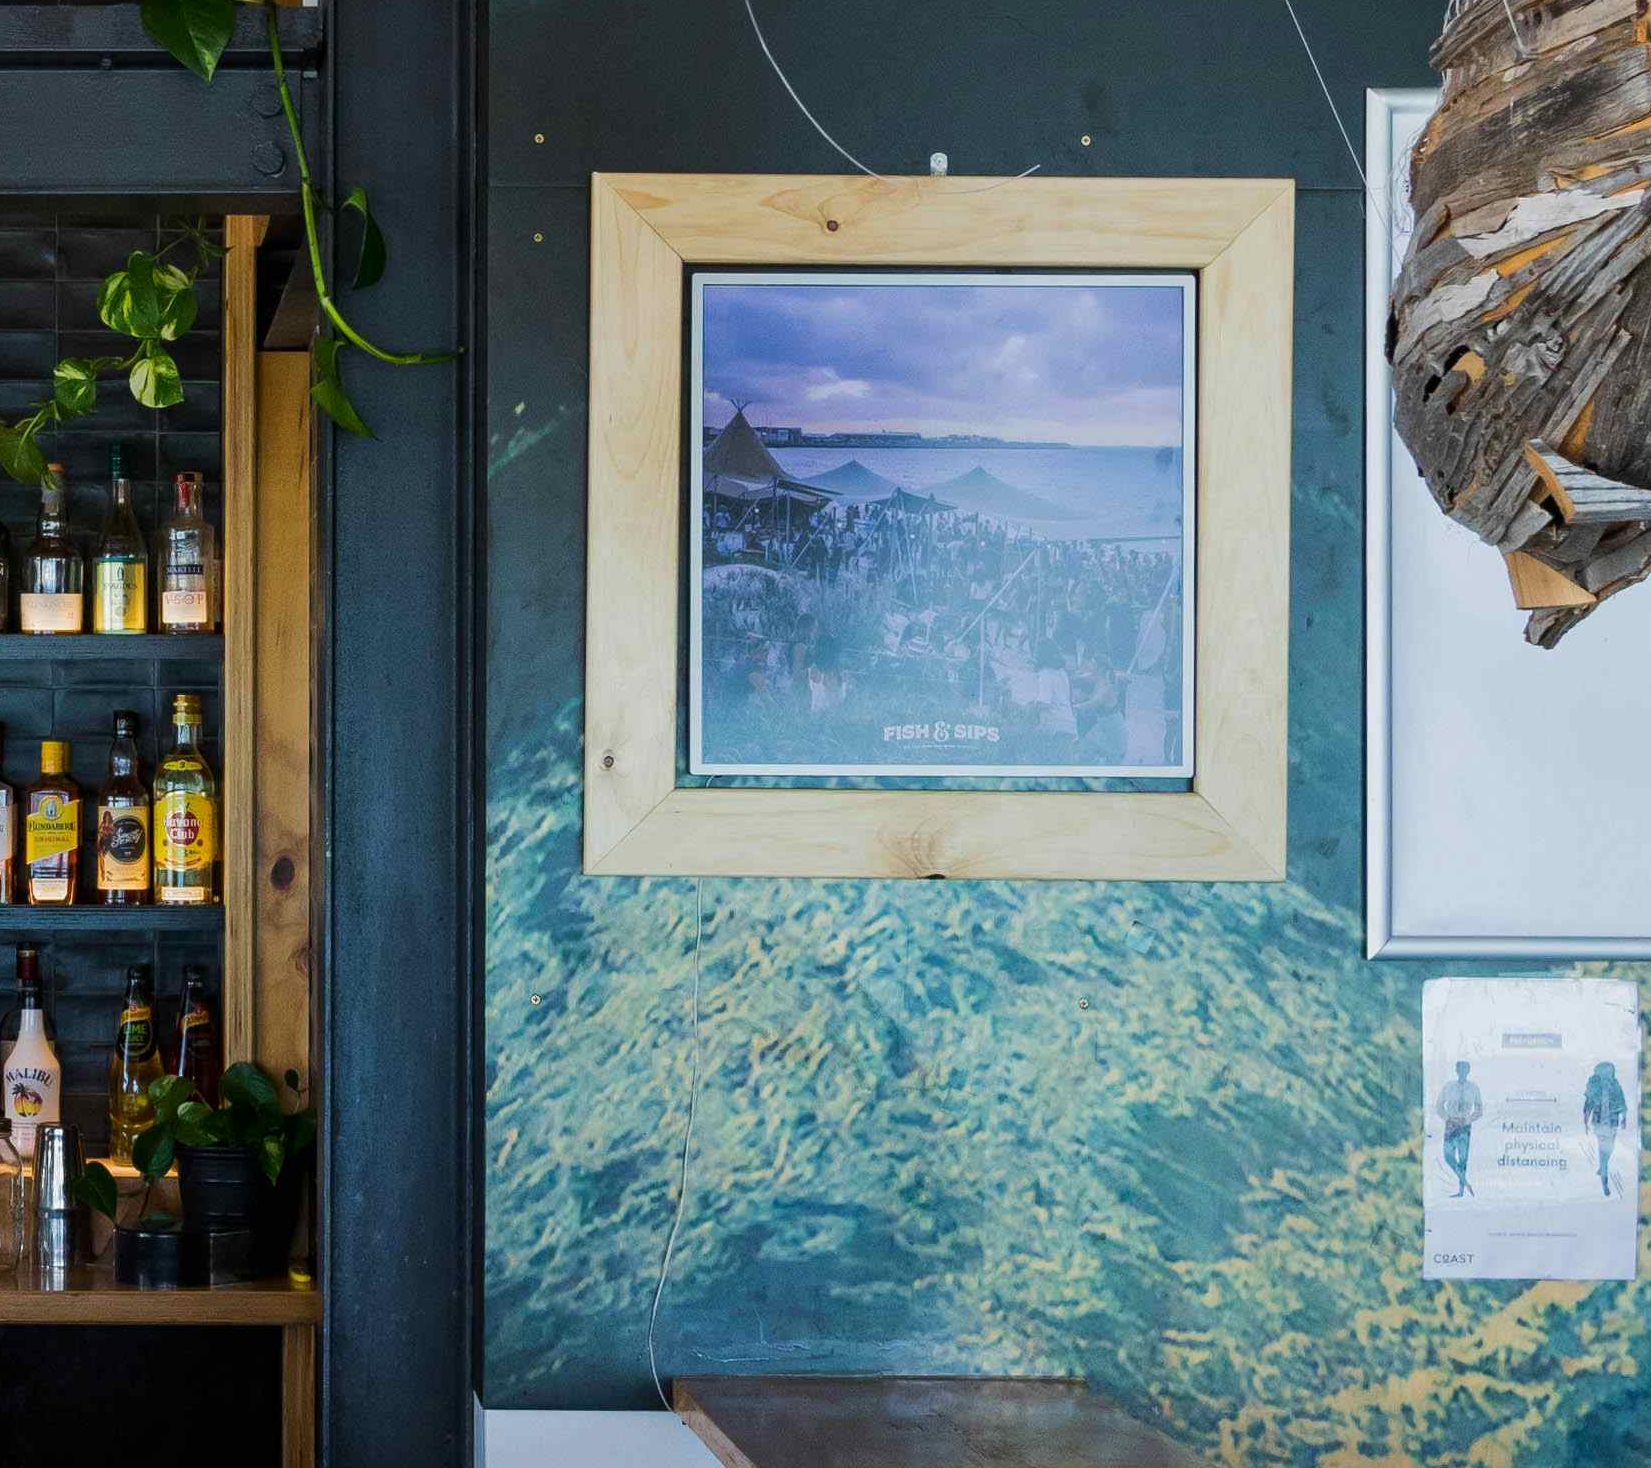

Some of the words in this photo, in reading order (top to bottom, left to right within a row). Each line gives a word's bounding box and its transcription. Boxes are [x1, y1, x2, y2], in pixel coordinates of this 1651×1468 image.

[883, 724, 930, 741] FISH
[933, 721, 949, 742] &
[953, 724, 1000, 742] SIPS
[6, 1067, 54, 1087] MALIBU
[1501, 1122, 1563, 1134] Maintain
[1504, 1138, 1560, 1154] physical
[1497, 1156, 1568, 1172] distancing
[1433, 1253, 1475, 1264] COAST
